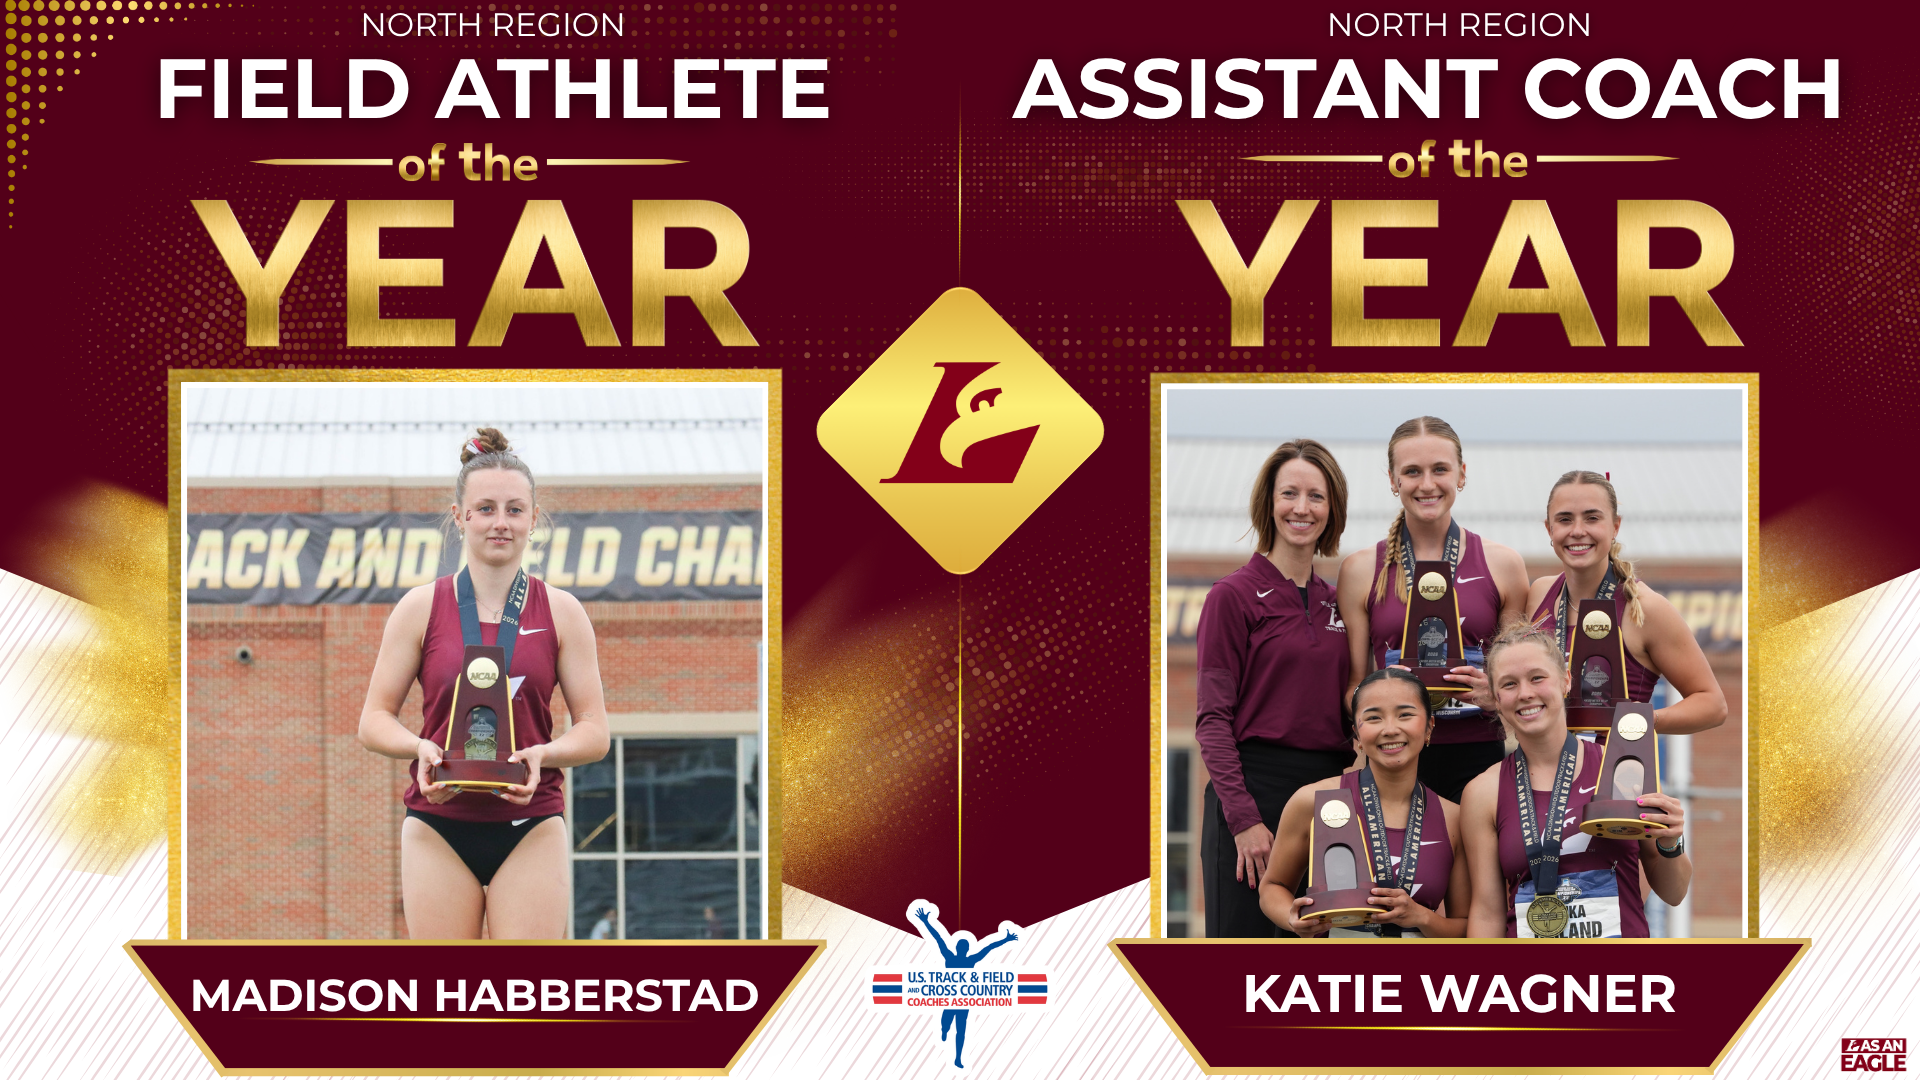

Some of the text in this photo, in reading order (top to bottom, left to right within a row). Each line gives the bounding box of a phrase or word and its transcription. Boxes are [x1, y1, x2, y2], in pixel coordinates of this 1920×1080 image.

[187, 525, 763, 589] ACK AND ELD CHA
[514, 574, 527, 609] ALL-A
[1421, 585, 1446, 594] NCAA
[502, 615, 519, 626] 2026
[1585, 624, 1610, 633] NCAA
[470, 672, 497, 681] NCAA
[1515, 760, 1534, 846] ALL-AMERICAN
[1552, 753, 1576, 842] ALL-AMERICAN
[1362, 786, 1386, 881] ALL-AMERICAN
[1404, 797, 1423, 891] ALL-AMERICAN
[1529, 854, 1560, 867] 202 2026
[1566, 904, 1587, 919] KA
